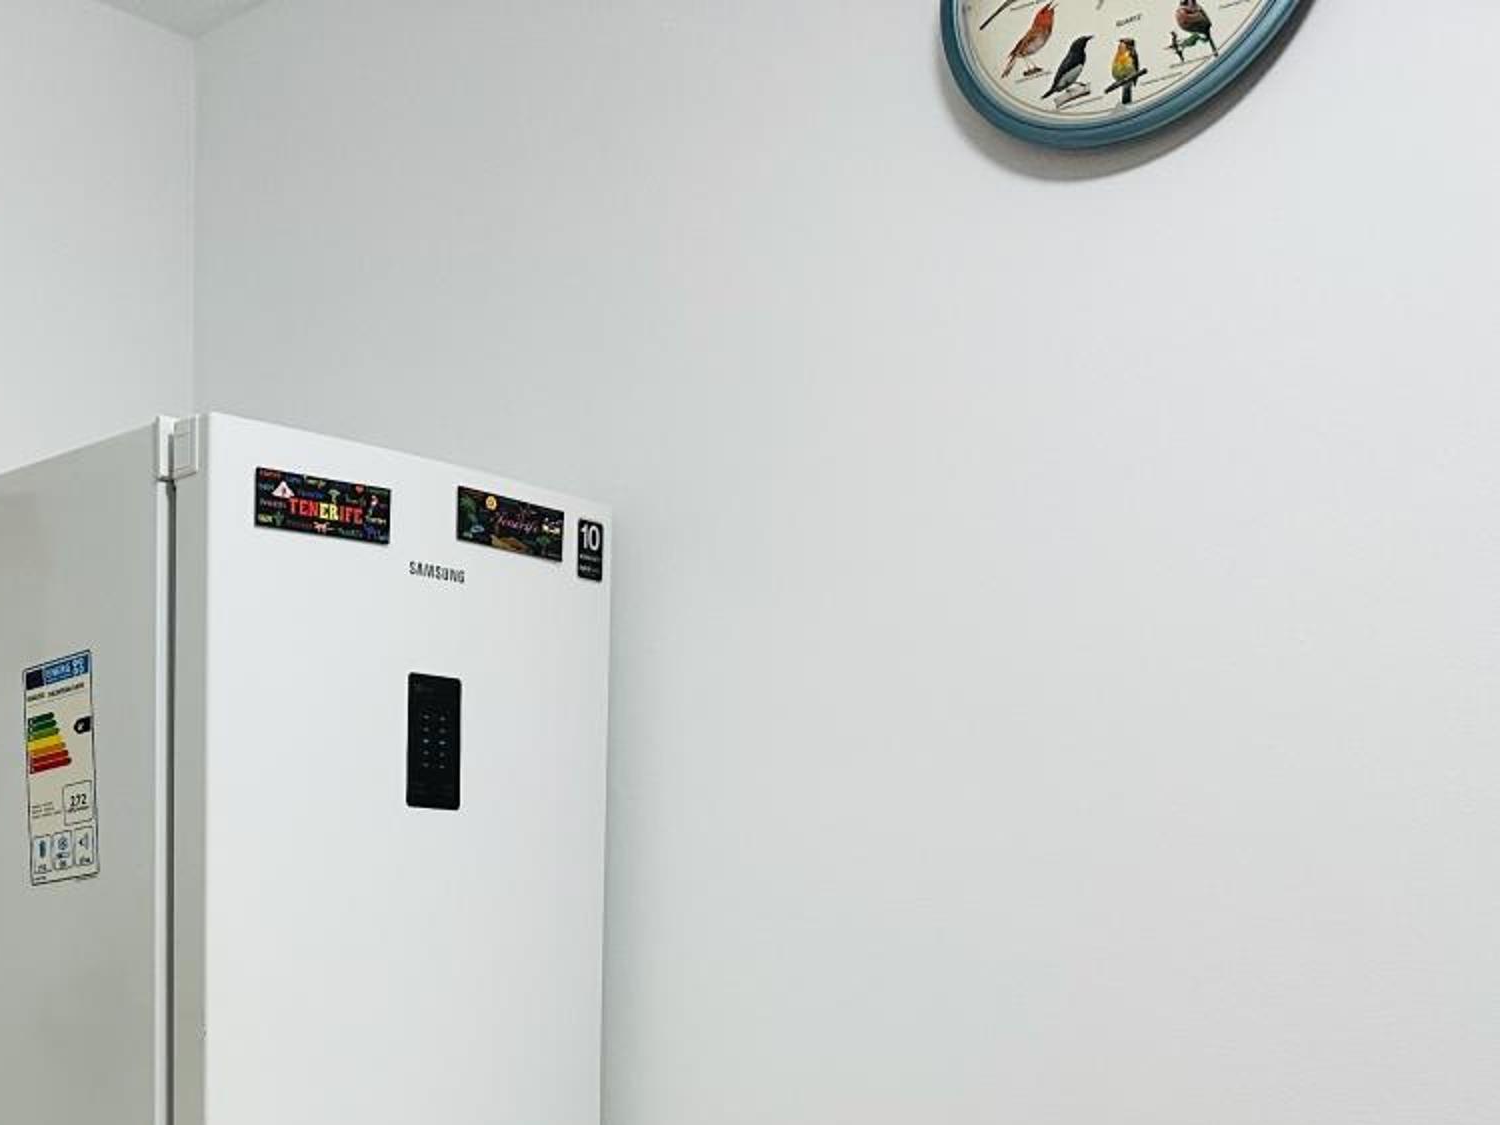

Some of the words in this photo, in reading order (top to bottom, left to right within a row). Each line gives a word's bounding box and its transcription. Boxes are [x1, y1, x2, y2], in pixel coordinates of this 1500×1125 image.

[290, 498, 363, 524] TENERIFE
[580, 523, 600, 550] 10
[409, 561, 465, 583] SAMSUNG
